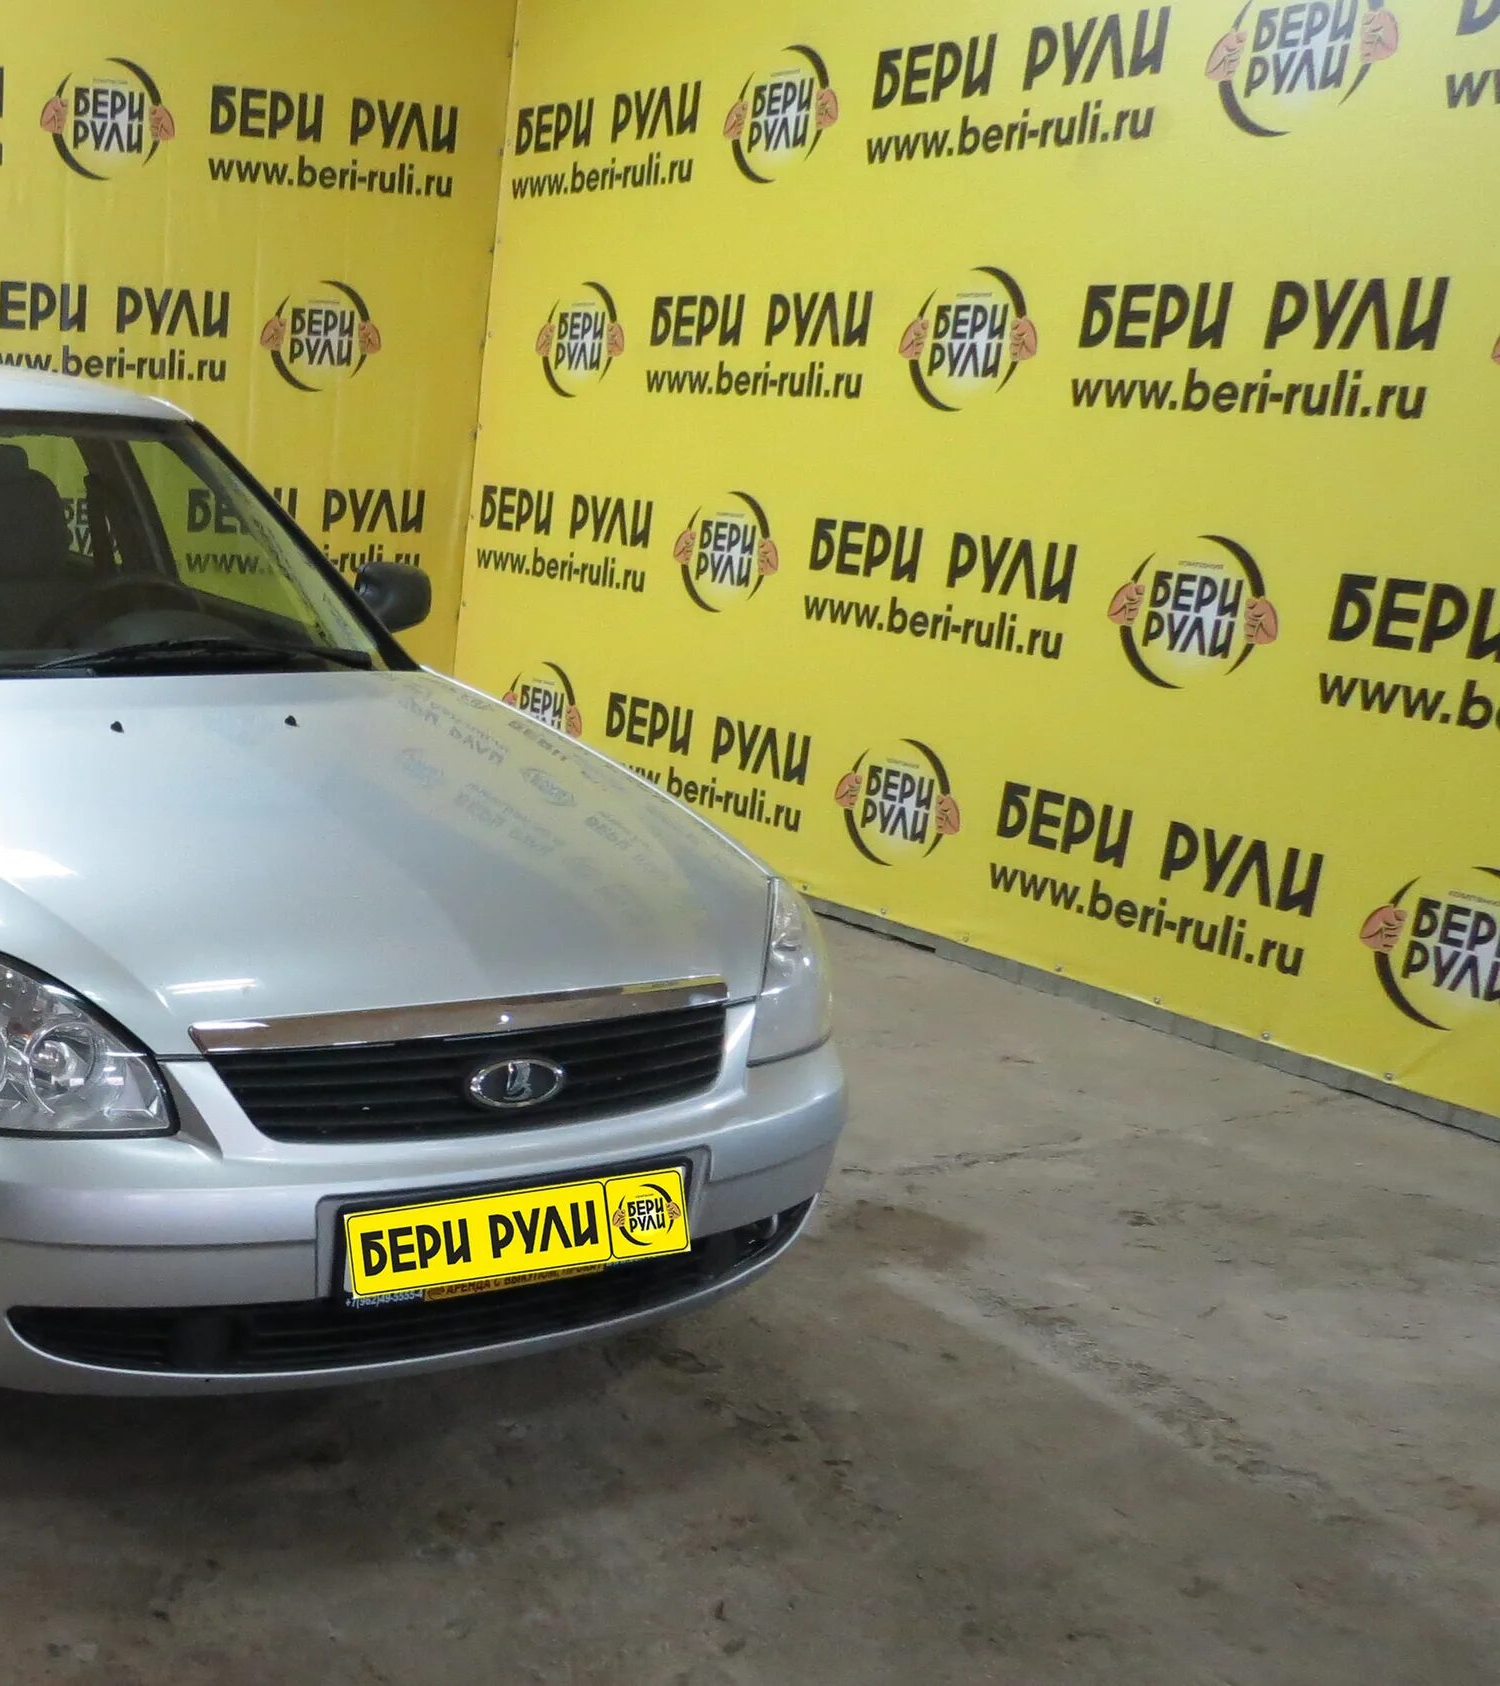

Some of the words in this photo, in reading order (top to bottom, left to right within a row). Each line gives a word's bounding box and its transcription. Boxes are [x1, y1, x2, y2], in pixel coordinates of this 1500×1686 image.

[1252, 0, 1358, 52] БЕРИ
[872, 34, 997, 109] БЕРИ
[1023, 7, 1170, 91] РУЛИ
[1244, 44, 1349, 98] РУЛИ
[74, 87, 144, 122] БЕРИ
[211, 85, 323, 142] БЕРИ
[350, 98, 458, 153] РУЛИ
[515, 98, 594, 155] БЕРИ
[611, 81, 701, 143] РУЛИ
[752, 78, 814, 118] БЕРИ
[73, 120, 143, 153] РУЛИ
[747, 114, 809, 153] РУЛИ
[867, 100, 1154, 164] www.beri-ruli.ru
[208, 155, 452, 198] www.beri-ruli.ru
[512, 152, 693, 199] www.beri-ruli.ru
[116, 287, 229, 338] РУЛИ
[291, 308, 354, 338] БЕРИ
[558, 312, 605, 340] БЕРИ
[650, 294, 745, 346] БЕРИ
[765, 291, 873, 346] РУЛИ
[933, 304, 1009, 339] БЕРИ
[1079, 282, 1233, 349] БЕРИ
[1264, 277, 1450, 350] РУЛИ
[289, 337, 352, 366] РУЛИ
[554, 342, 602, 370] РУЛИ
[928, 342, 1002, 378] РУЛИ
[647, 361, 862, 399] www.beri-ruli.ru
[1072, 368, 1427, 420] www.beri-ruli.ru
[322, 488, 426, 533] РУЛИ
[480, 485, 553, 535] БЕРИ
[570, 495, 653, 548] РУЛИ
[699, 520, 756, 555] БЕРИ
[809, 518, 923, 583] БЕРИ
[947, 532, 1077, 604] РУЛИ
[477, 547, 645, 592] www.beri-ruli.ru
[695, 552, 752, 587] РУЛИ
[1149, 571, 1243, 618] БЕРИ
[805, 595, 1063, 659] www.beri-ruli.ru
[1142, 611, 1235, 659] РУЛИ
[519, 684, 564, 720] БЕРИ
[606, 692, 693, 756] БЕРИ
[711, 716, 811, 785] РУЛИ
[622, 763, 801, 832] wberi-ruli.ru
[866, 765, 934, 810] БЕРИ
[861, 798, 929, 844] РУЛИ
[997, 781, 1133, 868] БЕРИ
[1159, 821, 1324, 917] РУЛИ
[990, 862, 1304, 976] www.beri-ruli.ru
[1412, 897, 1500, 958] БЕР
